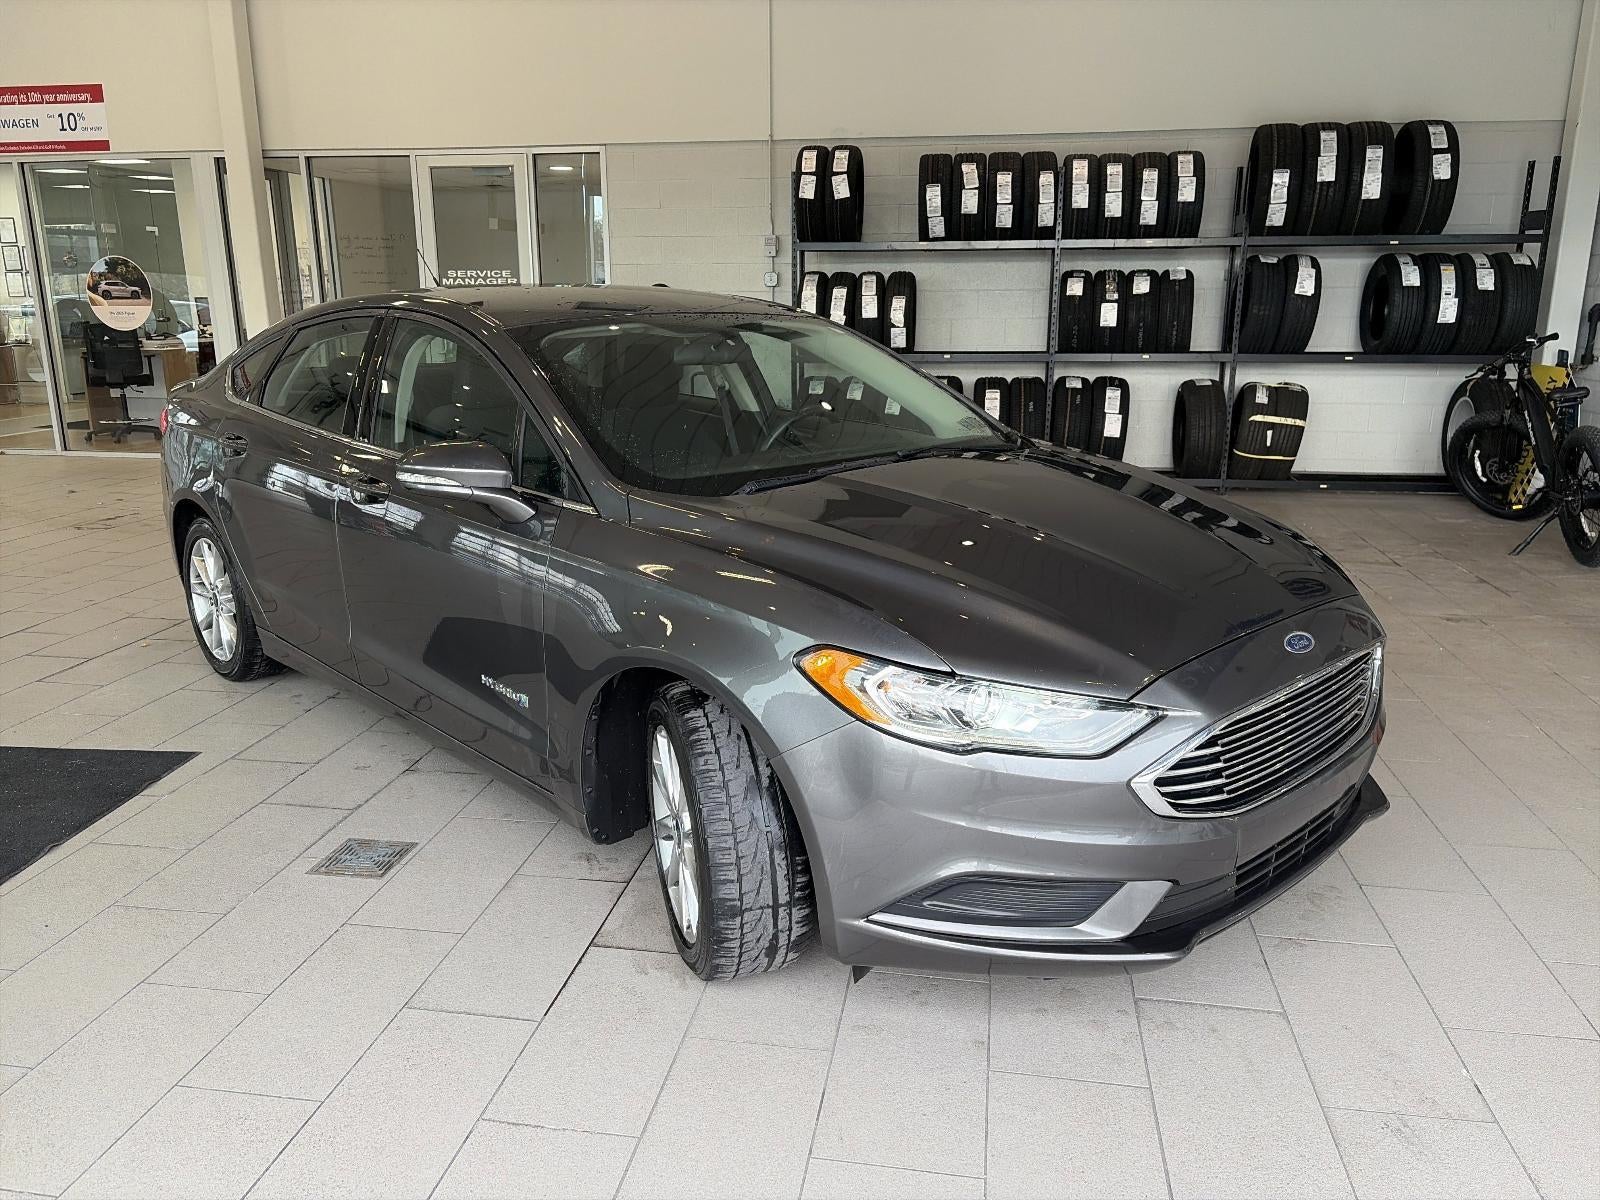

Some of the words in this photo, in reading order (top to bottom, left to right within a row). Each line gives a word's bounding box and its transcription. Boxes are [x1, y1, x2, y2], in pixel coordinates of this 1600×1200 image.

[0, 92, 18, 105] rating
[28, 91, 42, 103] 10th
[43, 93, 56, 104] year
[57, 91, 93, 103] anniversary.
[0, 118, 39, 129] WAGEN
[447, 270, 512, 278] SERVICE
[442, 278, 518, 286] MANAGER
[1290, 636, 1309, 650] Ford
